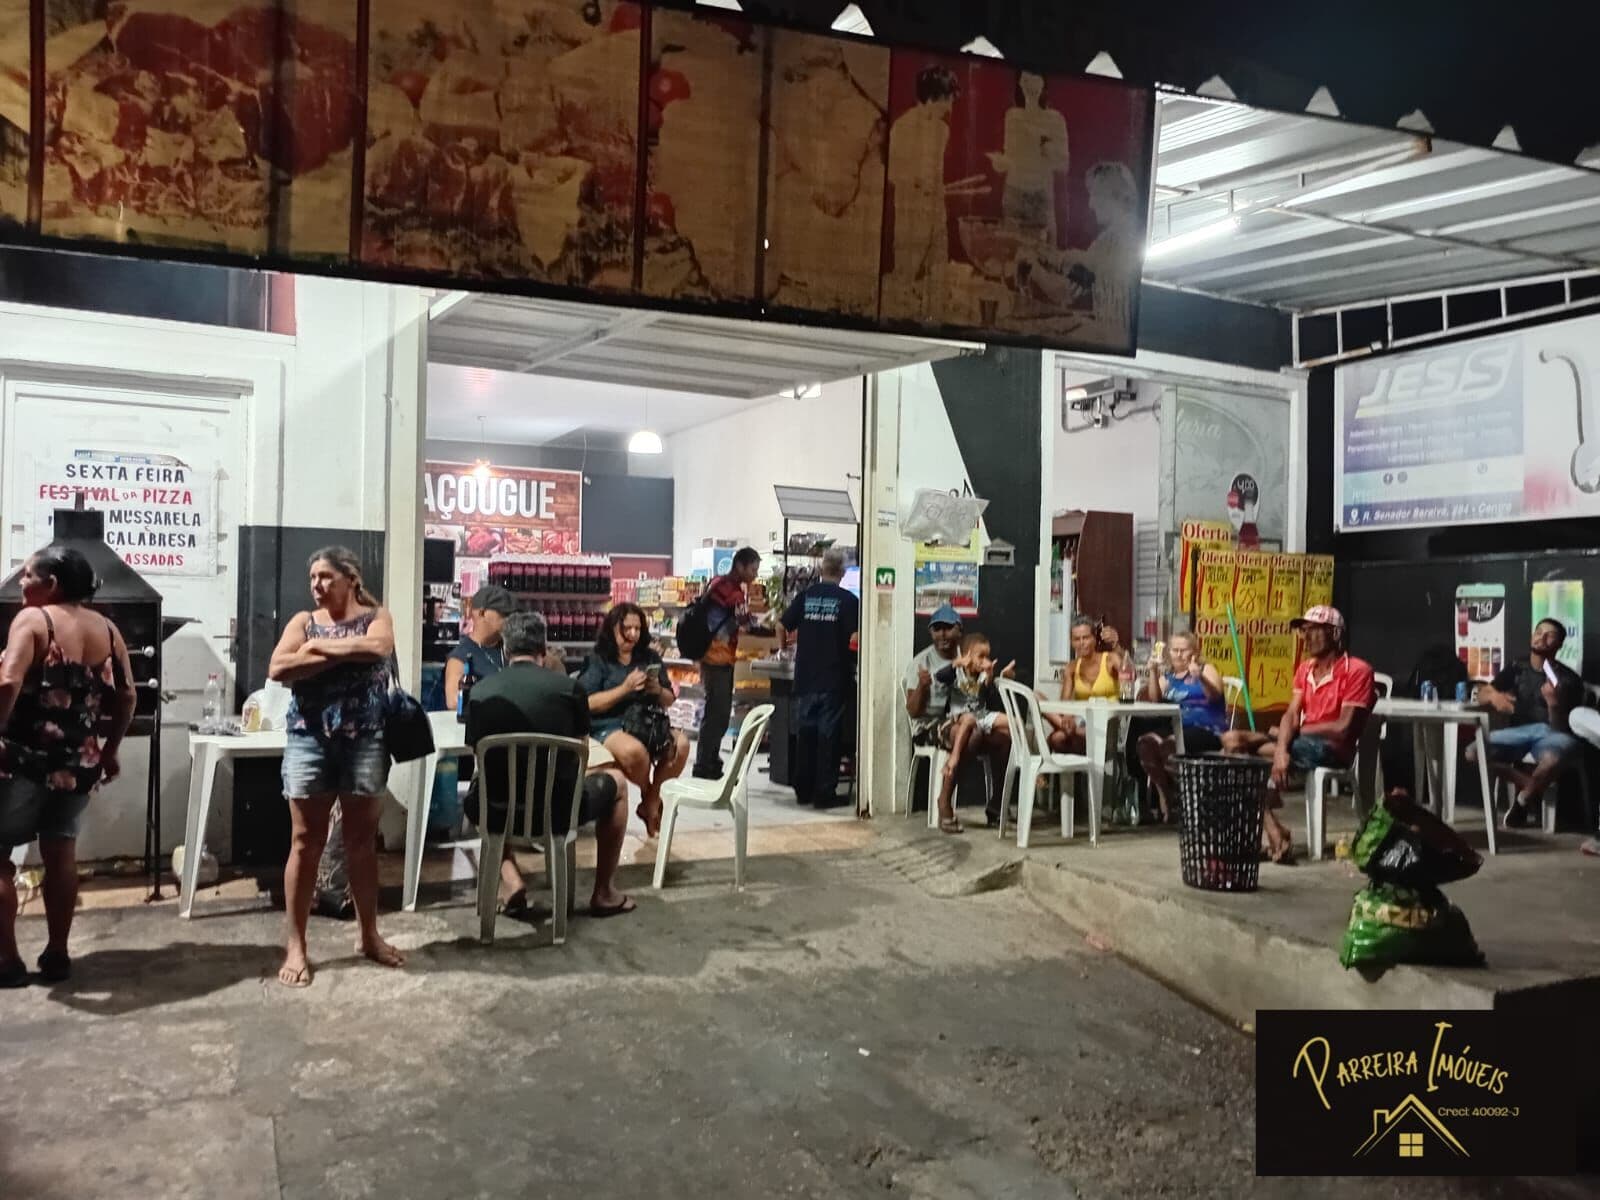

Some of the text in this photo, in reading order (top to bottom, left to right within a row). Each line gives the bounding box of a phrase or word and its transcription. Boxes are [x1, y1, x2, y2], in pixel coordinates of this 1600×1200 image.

[1358, 343, 1514, 406] JESS
[66, 463, 185, 483] SEXTA FEIRA
[39, 484, 192, 505] FESTIVAL DA PIZZA
[424, 472, 556, 520] AÇOUGUE
[109, 509, 201, 527] MUSSARELA
[106, 531, 196, 548] CALABRESA
[1183, 523, 1230, 541] Oferta
[125, 553, 184, 566] ASSADAS
[1201, 551, 1235, 565] Oferta
[1237, 553, 1268, 567] Oferta
[1270, 555, 1301, 569] Oferta
[1197, 618, 1245, 635] Ofera
[1249, 618, 1292, 635] Oferta
